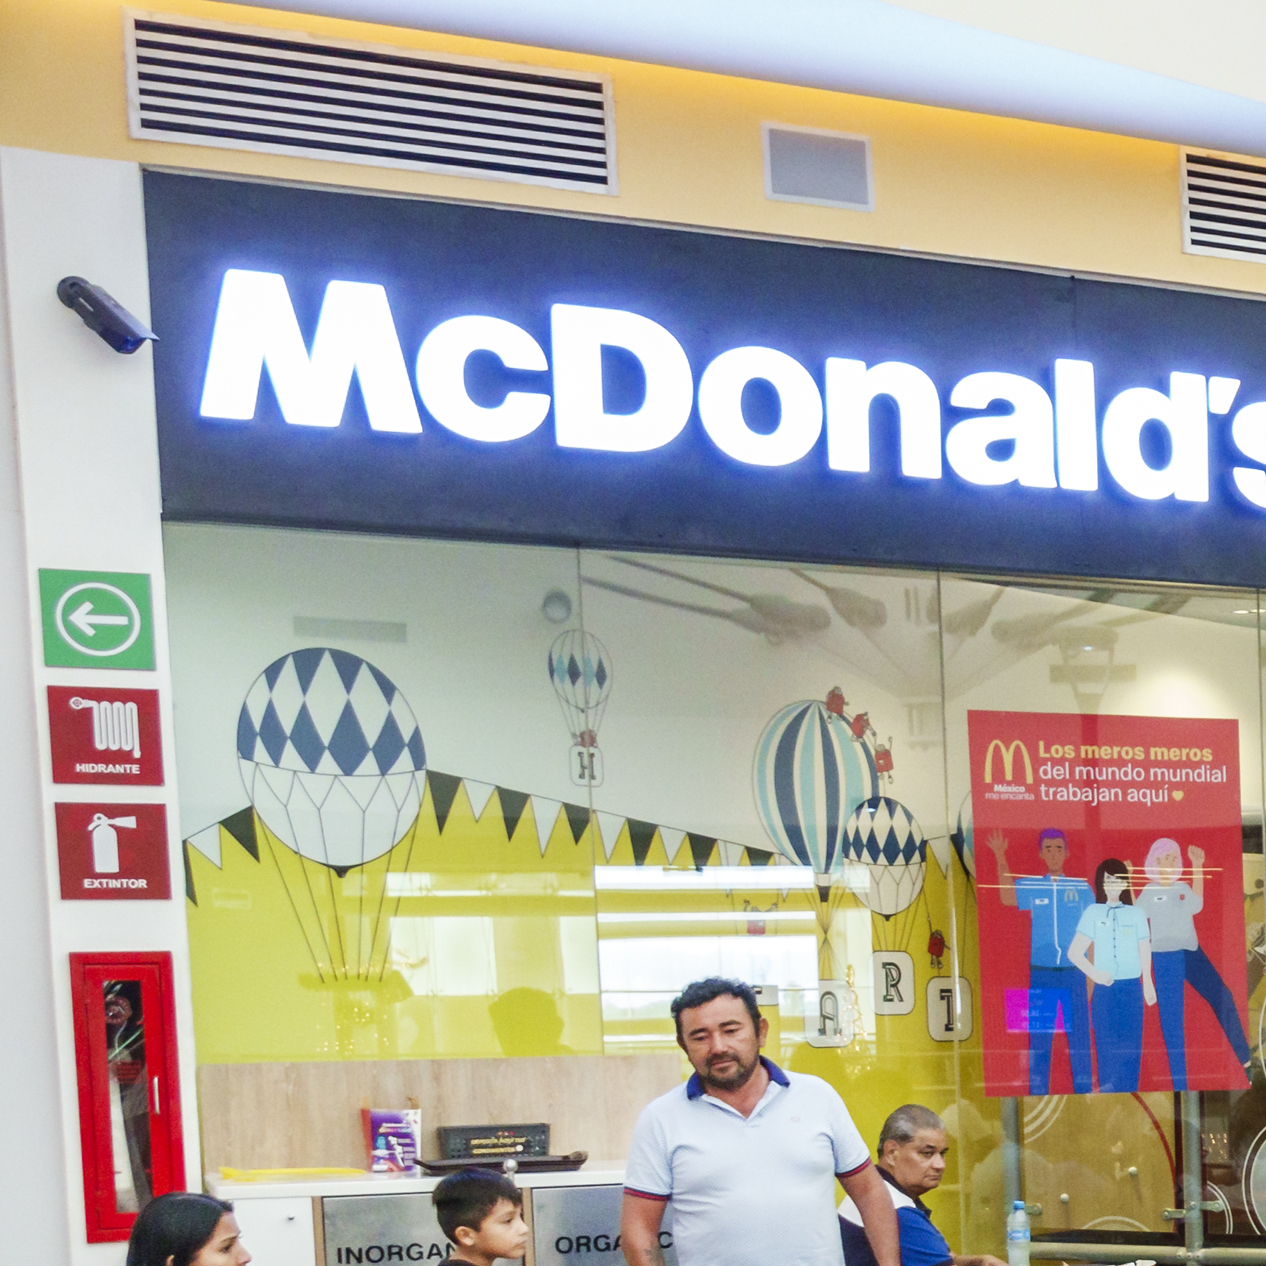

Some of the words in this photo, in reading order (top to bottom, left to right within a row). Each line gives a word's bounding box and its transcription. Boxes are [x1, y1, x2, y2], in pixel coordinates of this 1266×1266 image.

[1039, 740, 1075, 759] Los
[1080, 743, 1145, 761] meros
[1150, 745, 1213, 762] meros
[75, 763, 141, 774] HIDRANTE
[1039, 761, 1070, 780] del
[1075, 763, 1145, 781] mundo
[1150, 764, 1227, 783] mundial
[993, 783, 1025, 793] México
[1000, 792, 1035, 800] encanta
[1040, 783, 1122, 806] trabajan
[1127, 784, 1169, 806] aquí
[83, 878, 148, 889] EXTINTOR
[555, 1231, 674, 1254] ORGC
